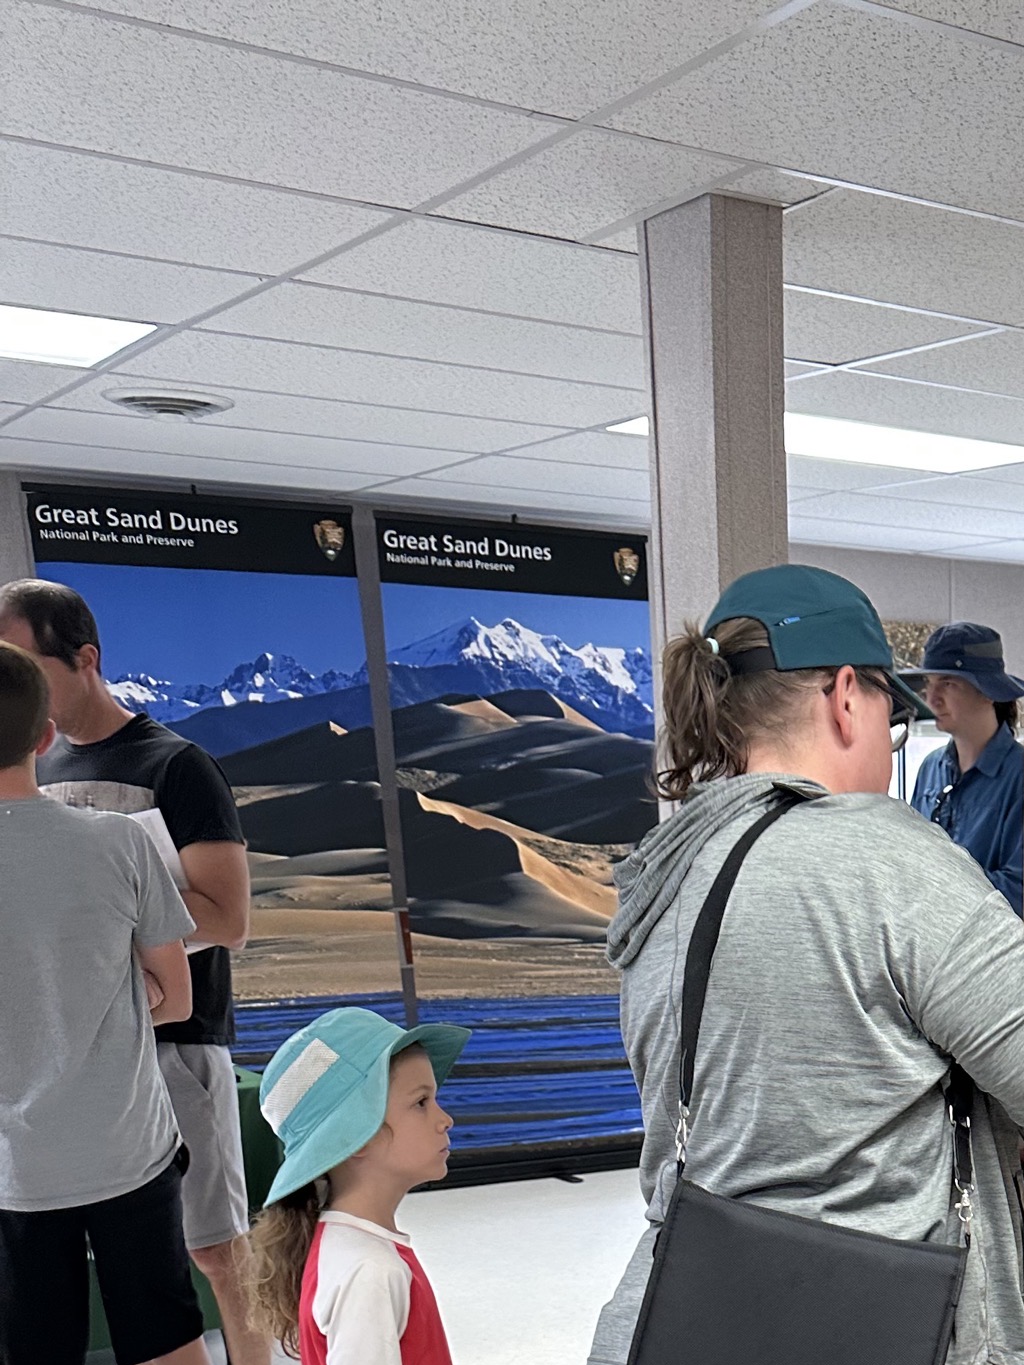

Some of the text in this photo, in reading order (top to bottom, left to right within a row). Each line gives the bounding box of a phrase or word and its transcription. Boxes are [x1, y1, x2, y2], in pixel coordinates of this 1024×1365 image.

[35, 504, 239, 534] Great Sand Dunes
[39, 529, 195, 548] National Park and Preserve
[383, 529, 552, 561] Great Sand Dunes
[386, 552, 516, 573] National Park and Preserve
